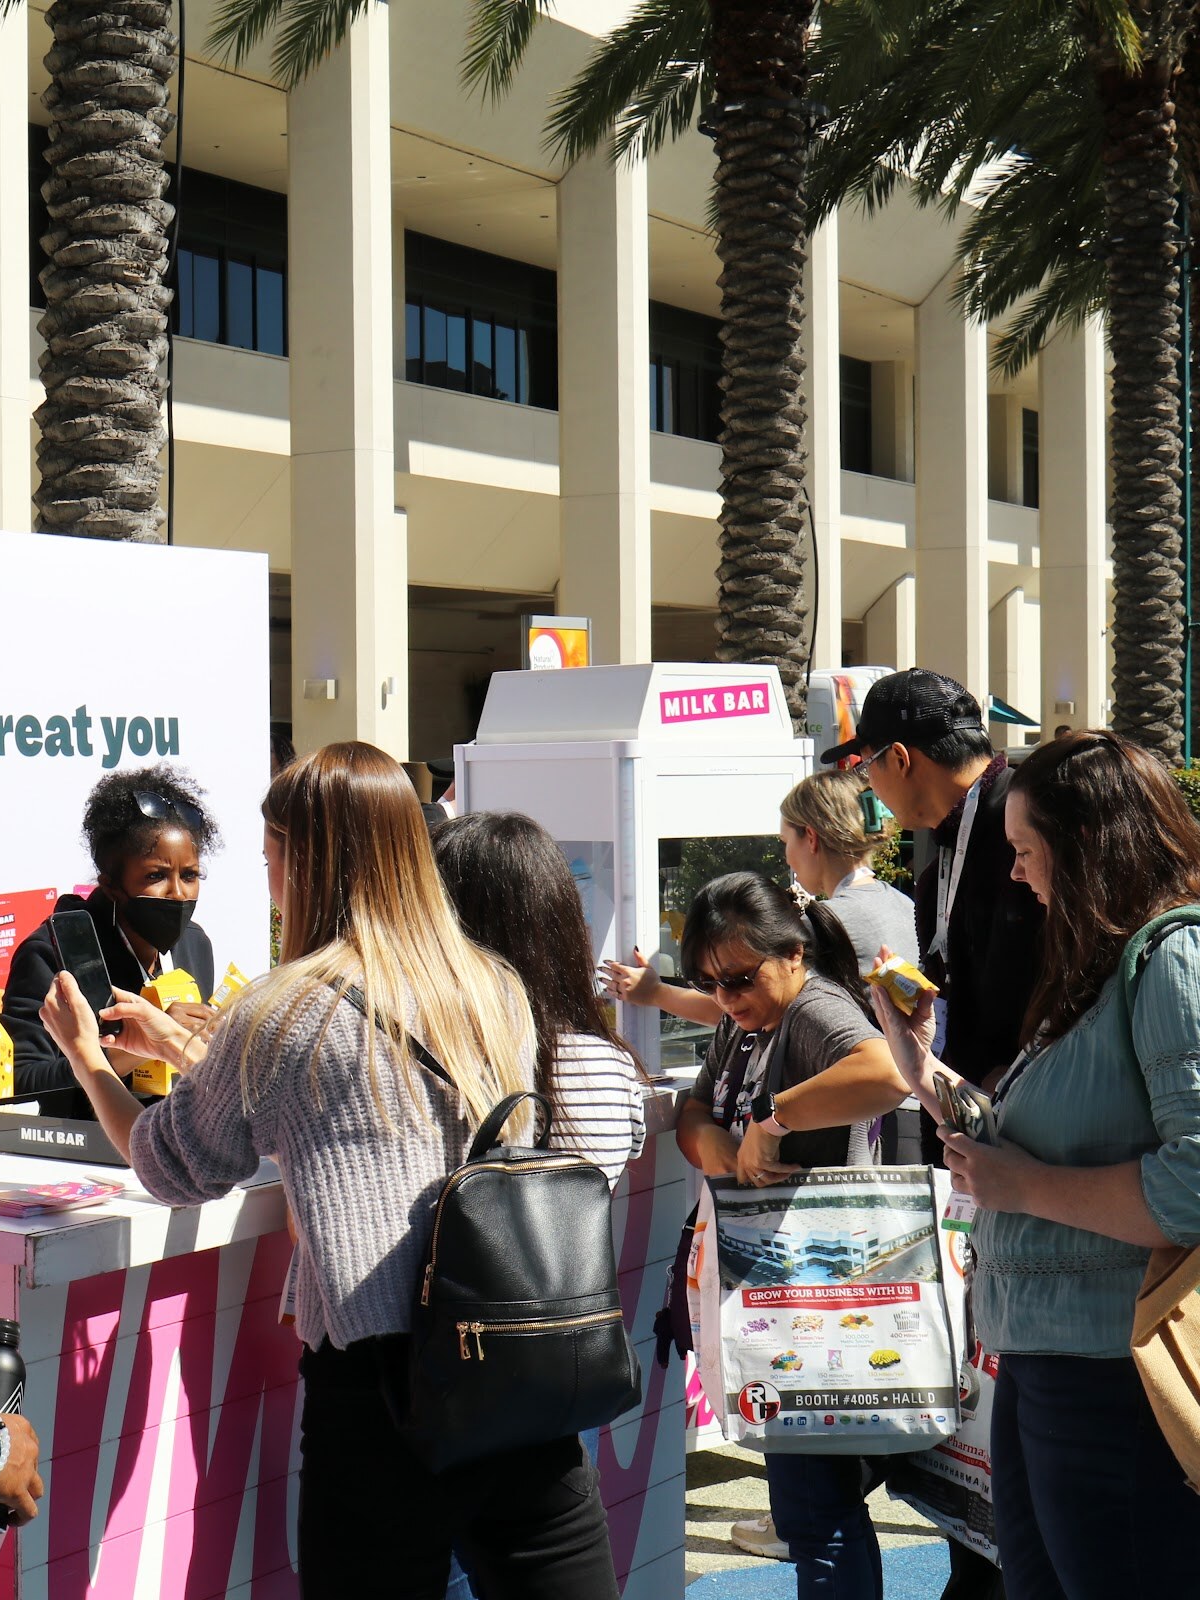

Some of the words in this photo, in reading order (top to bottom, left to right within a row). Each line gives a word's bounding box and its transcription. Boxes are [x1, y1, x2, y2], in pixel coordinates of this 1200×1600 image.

[664, 694, 717, 717] MILK
[723, 690, 765, 712] BAR
[100, 716, 180, 769] you
[21, 1127, 54, 1143] MILK
[56, 1132, 85, 1146] BAR
[818, 1174, 901, 1182] MANUFACTURER
[748, 1290, 782, 1300] GROW
[784, 1289, 813, 1298] YOUR
[815, 1288, 864, 1298] BUSINESS
[866, 1286, 895, 1296] WITH
[897, 1285, 913, 1294] US!
[796, 1395, 839, 1406] BOOTH
[843, 1394, 879, 1405] #4005
[892, 1393, 924, 1404] HALL
[928, 1392, 936, 1402] D
